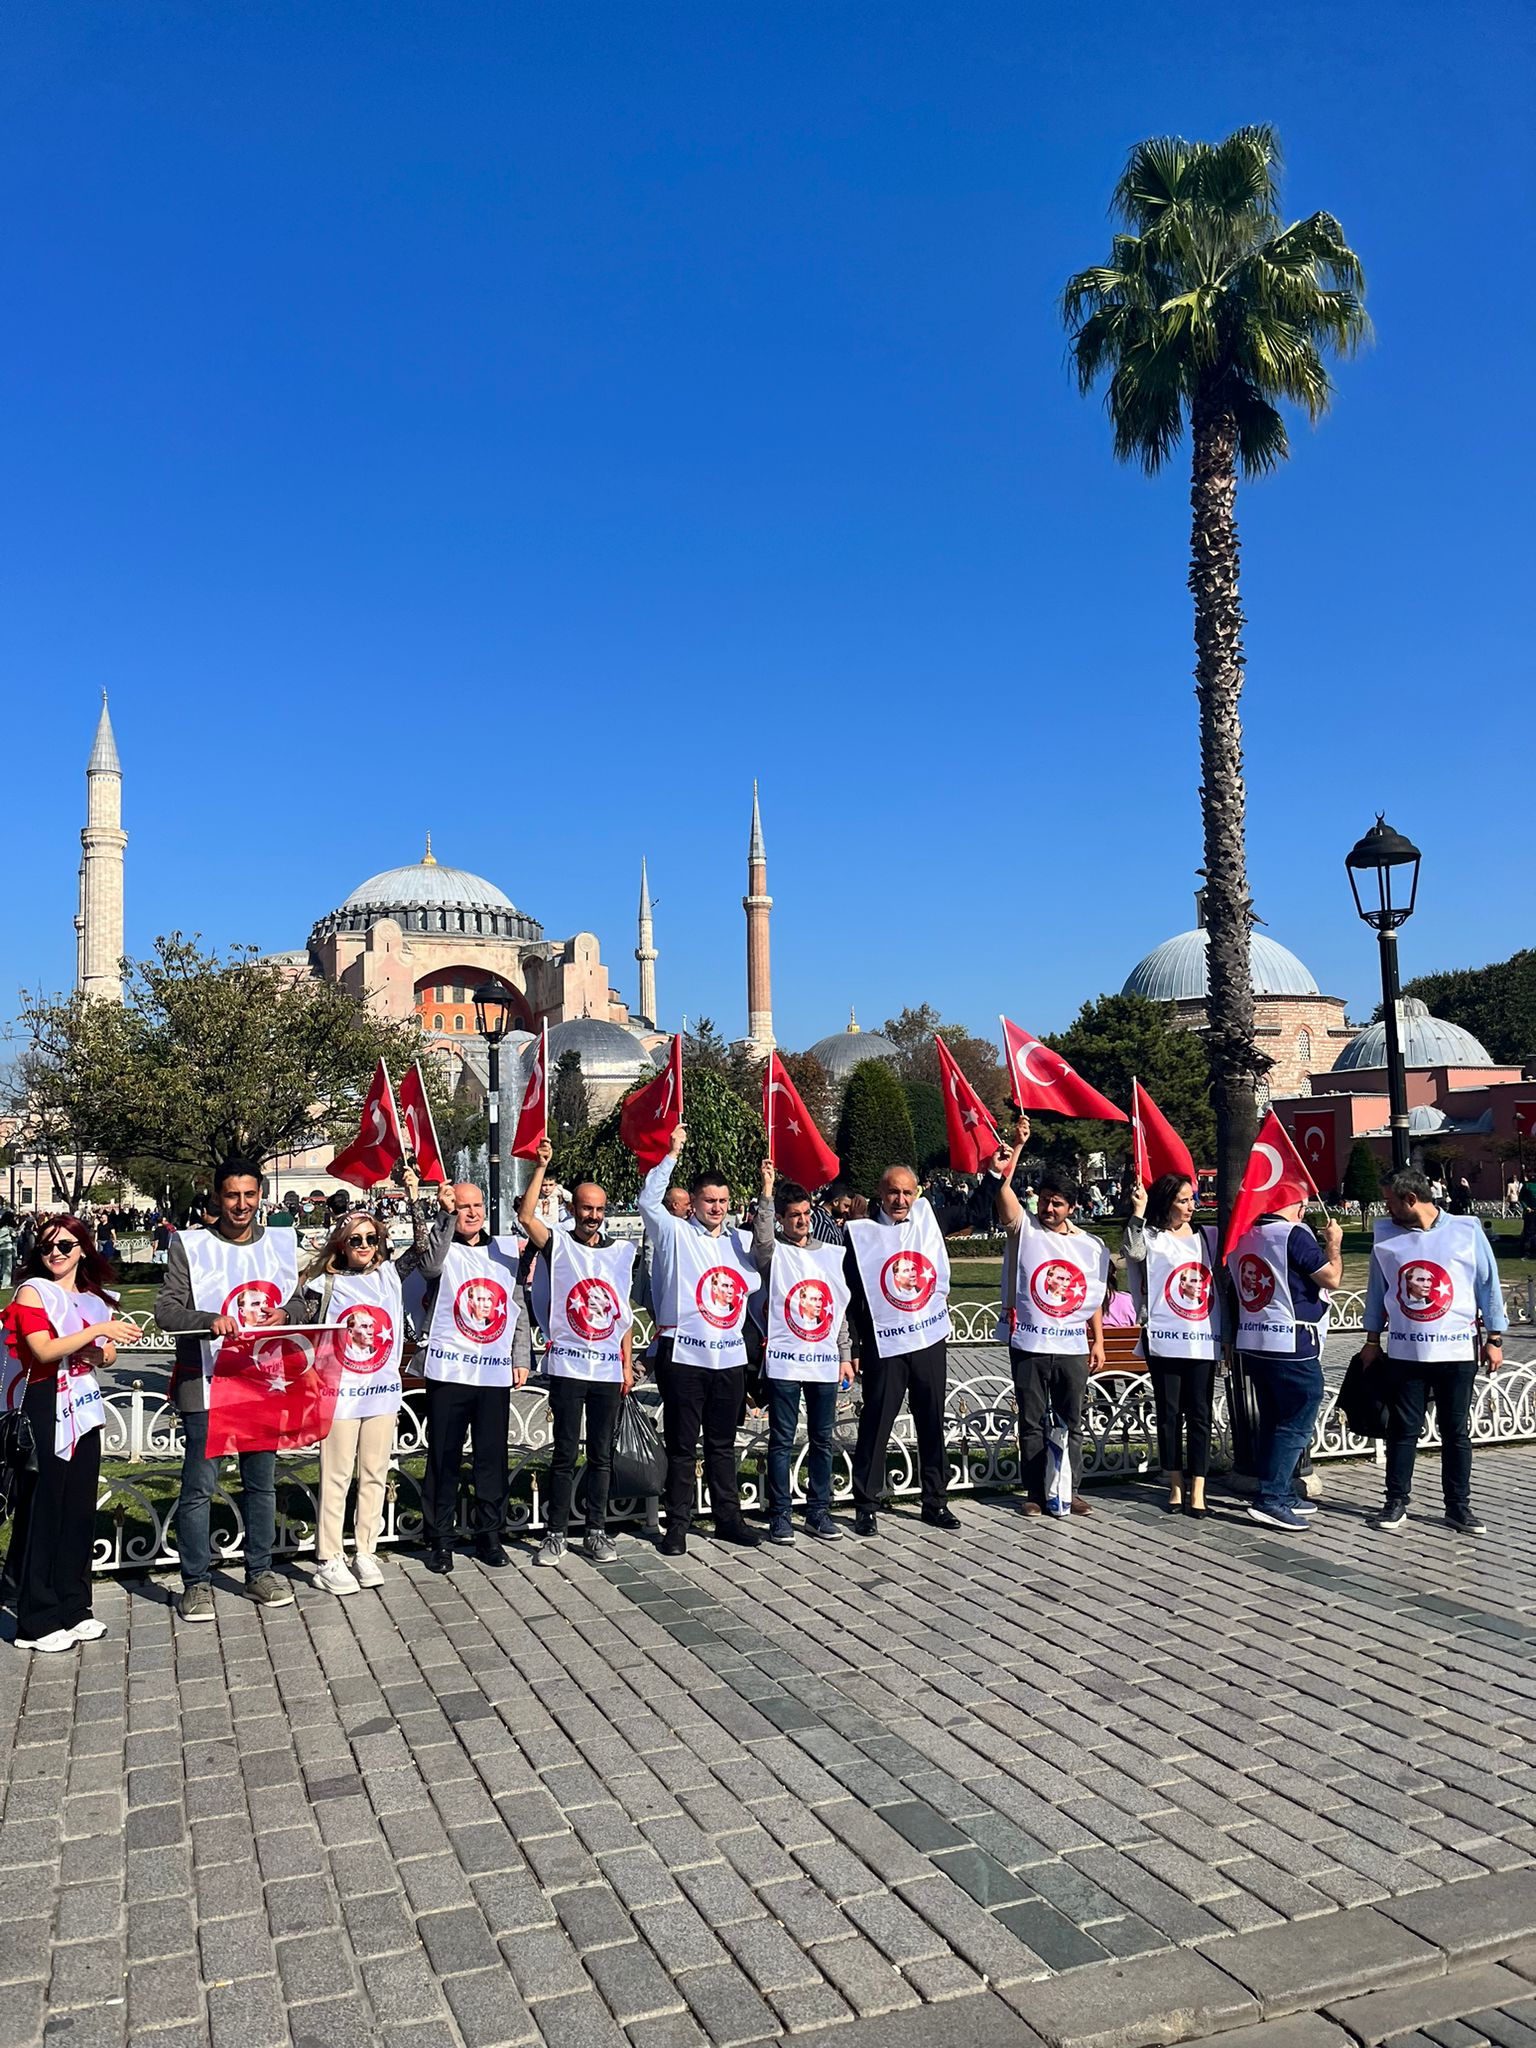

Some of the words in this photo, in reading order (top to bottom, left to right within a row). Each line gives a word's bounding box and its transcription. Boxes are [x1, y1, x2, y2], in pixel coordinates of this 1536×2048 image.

[877, 1326, 906, 1338] TÜRK
[1016, 1322, 1038, 1334] TÜRK
[1151, 1330, 1179, 1340] TÜRK
[1409, 1332, 1469, 1342] EĞİTİM-SEN
[677, 1335, 706, 1348] TÜRK
[430, 1348, 459, 1361] TÜRK
[462, 1353, 512, 1366] EĞİTİM-SE
[768, 1350, 795, 1361] TÜRK
[798, 1353, 841, 1363] EĞİTİM-SE
[320, 1386, 345, 1397] ÜRK
[349, 1382, 400, 1397] EĞİTİM-SE
